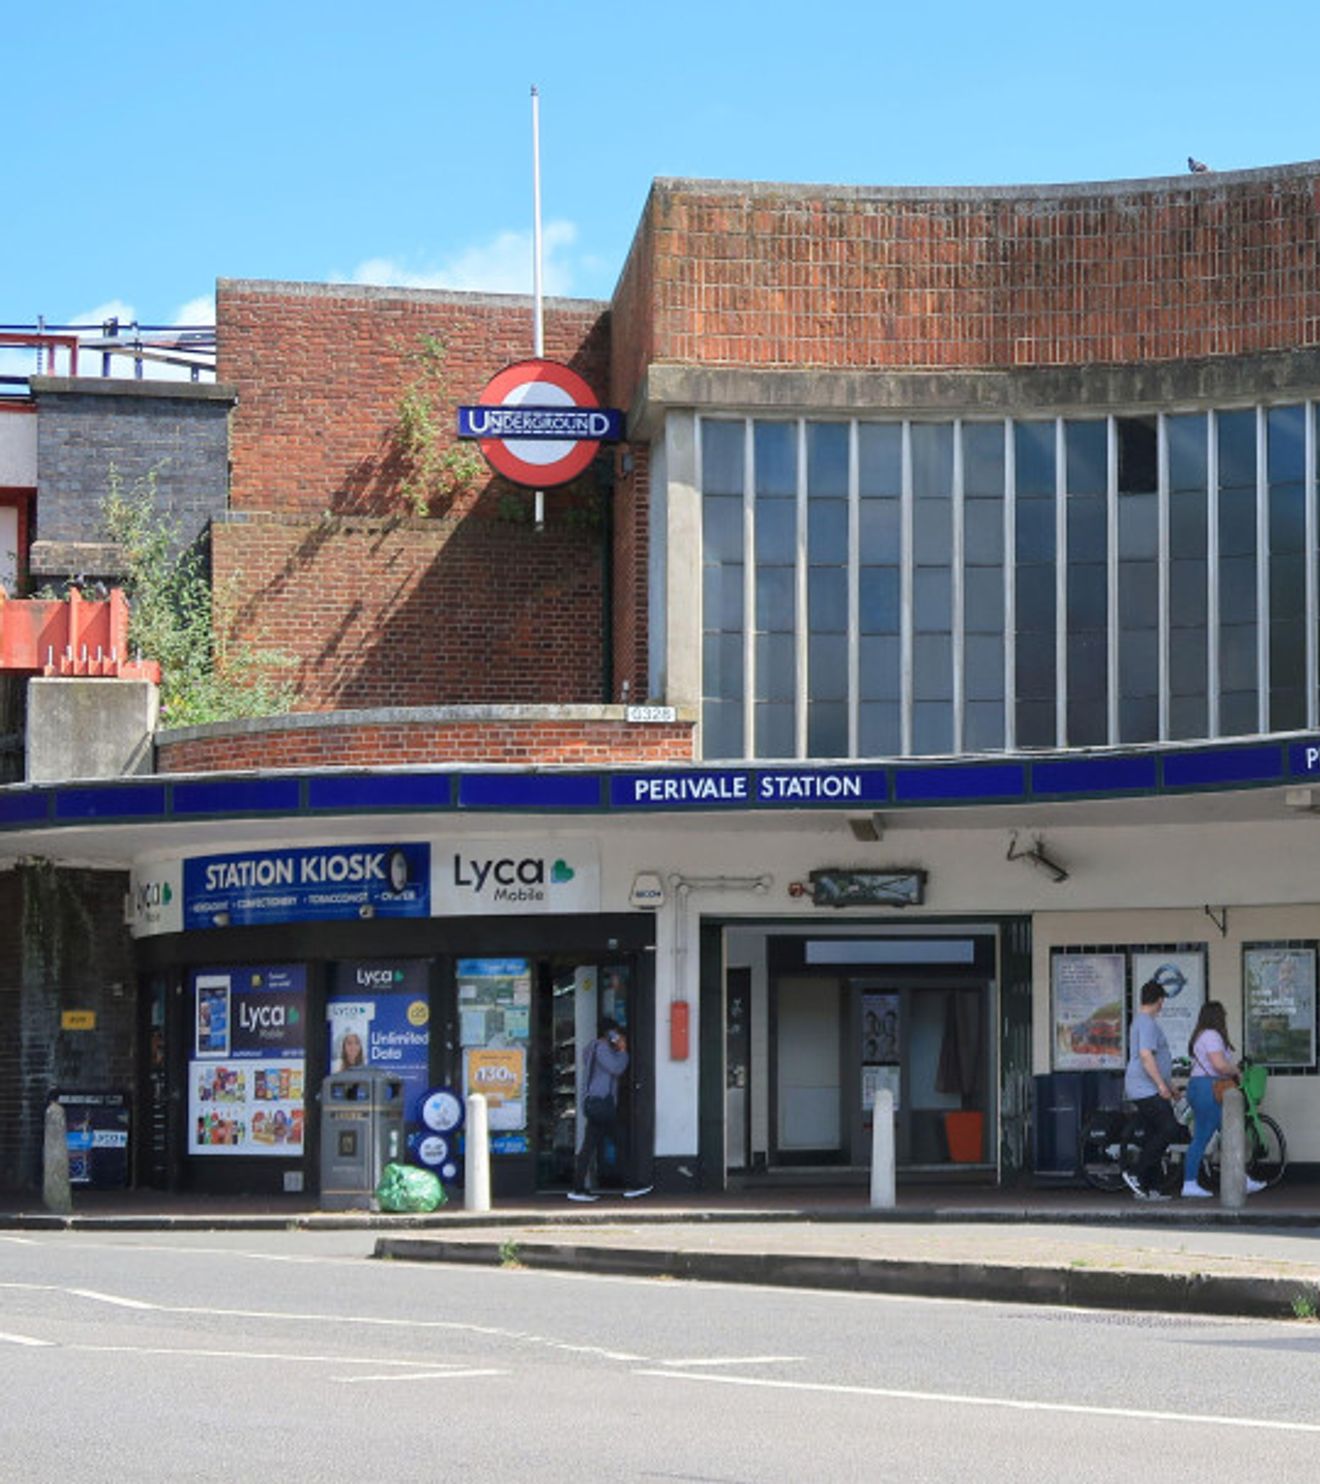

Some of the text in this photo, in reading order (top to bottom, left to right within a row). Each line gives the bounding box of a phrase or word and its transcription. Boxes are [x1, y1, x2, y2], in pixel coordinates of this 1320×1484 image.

[468, 410, 610, 436] UNDERGROUND
[635, 775, 861, 800] PERIVALE STATION
[205, 853, 386, 892] STATION KIOSK
[453, 853, 545, 892] Lyca
[494, 889, 545, 902] Mobile
[356, 969, 393, 986] Lyca
[240, 1002, 285, 1032] Lyca
[371, 1032, 429, 1045] Unlimited
[371, 1046, 402, 1060] Data
